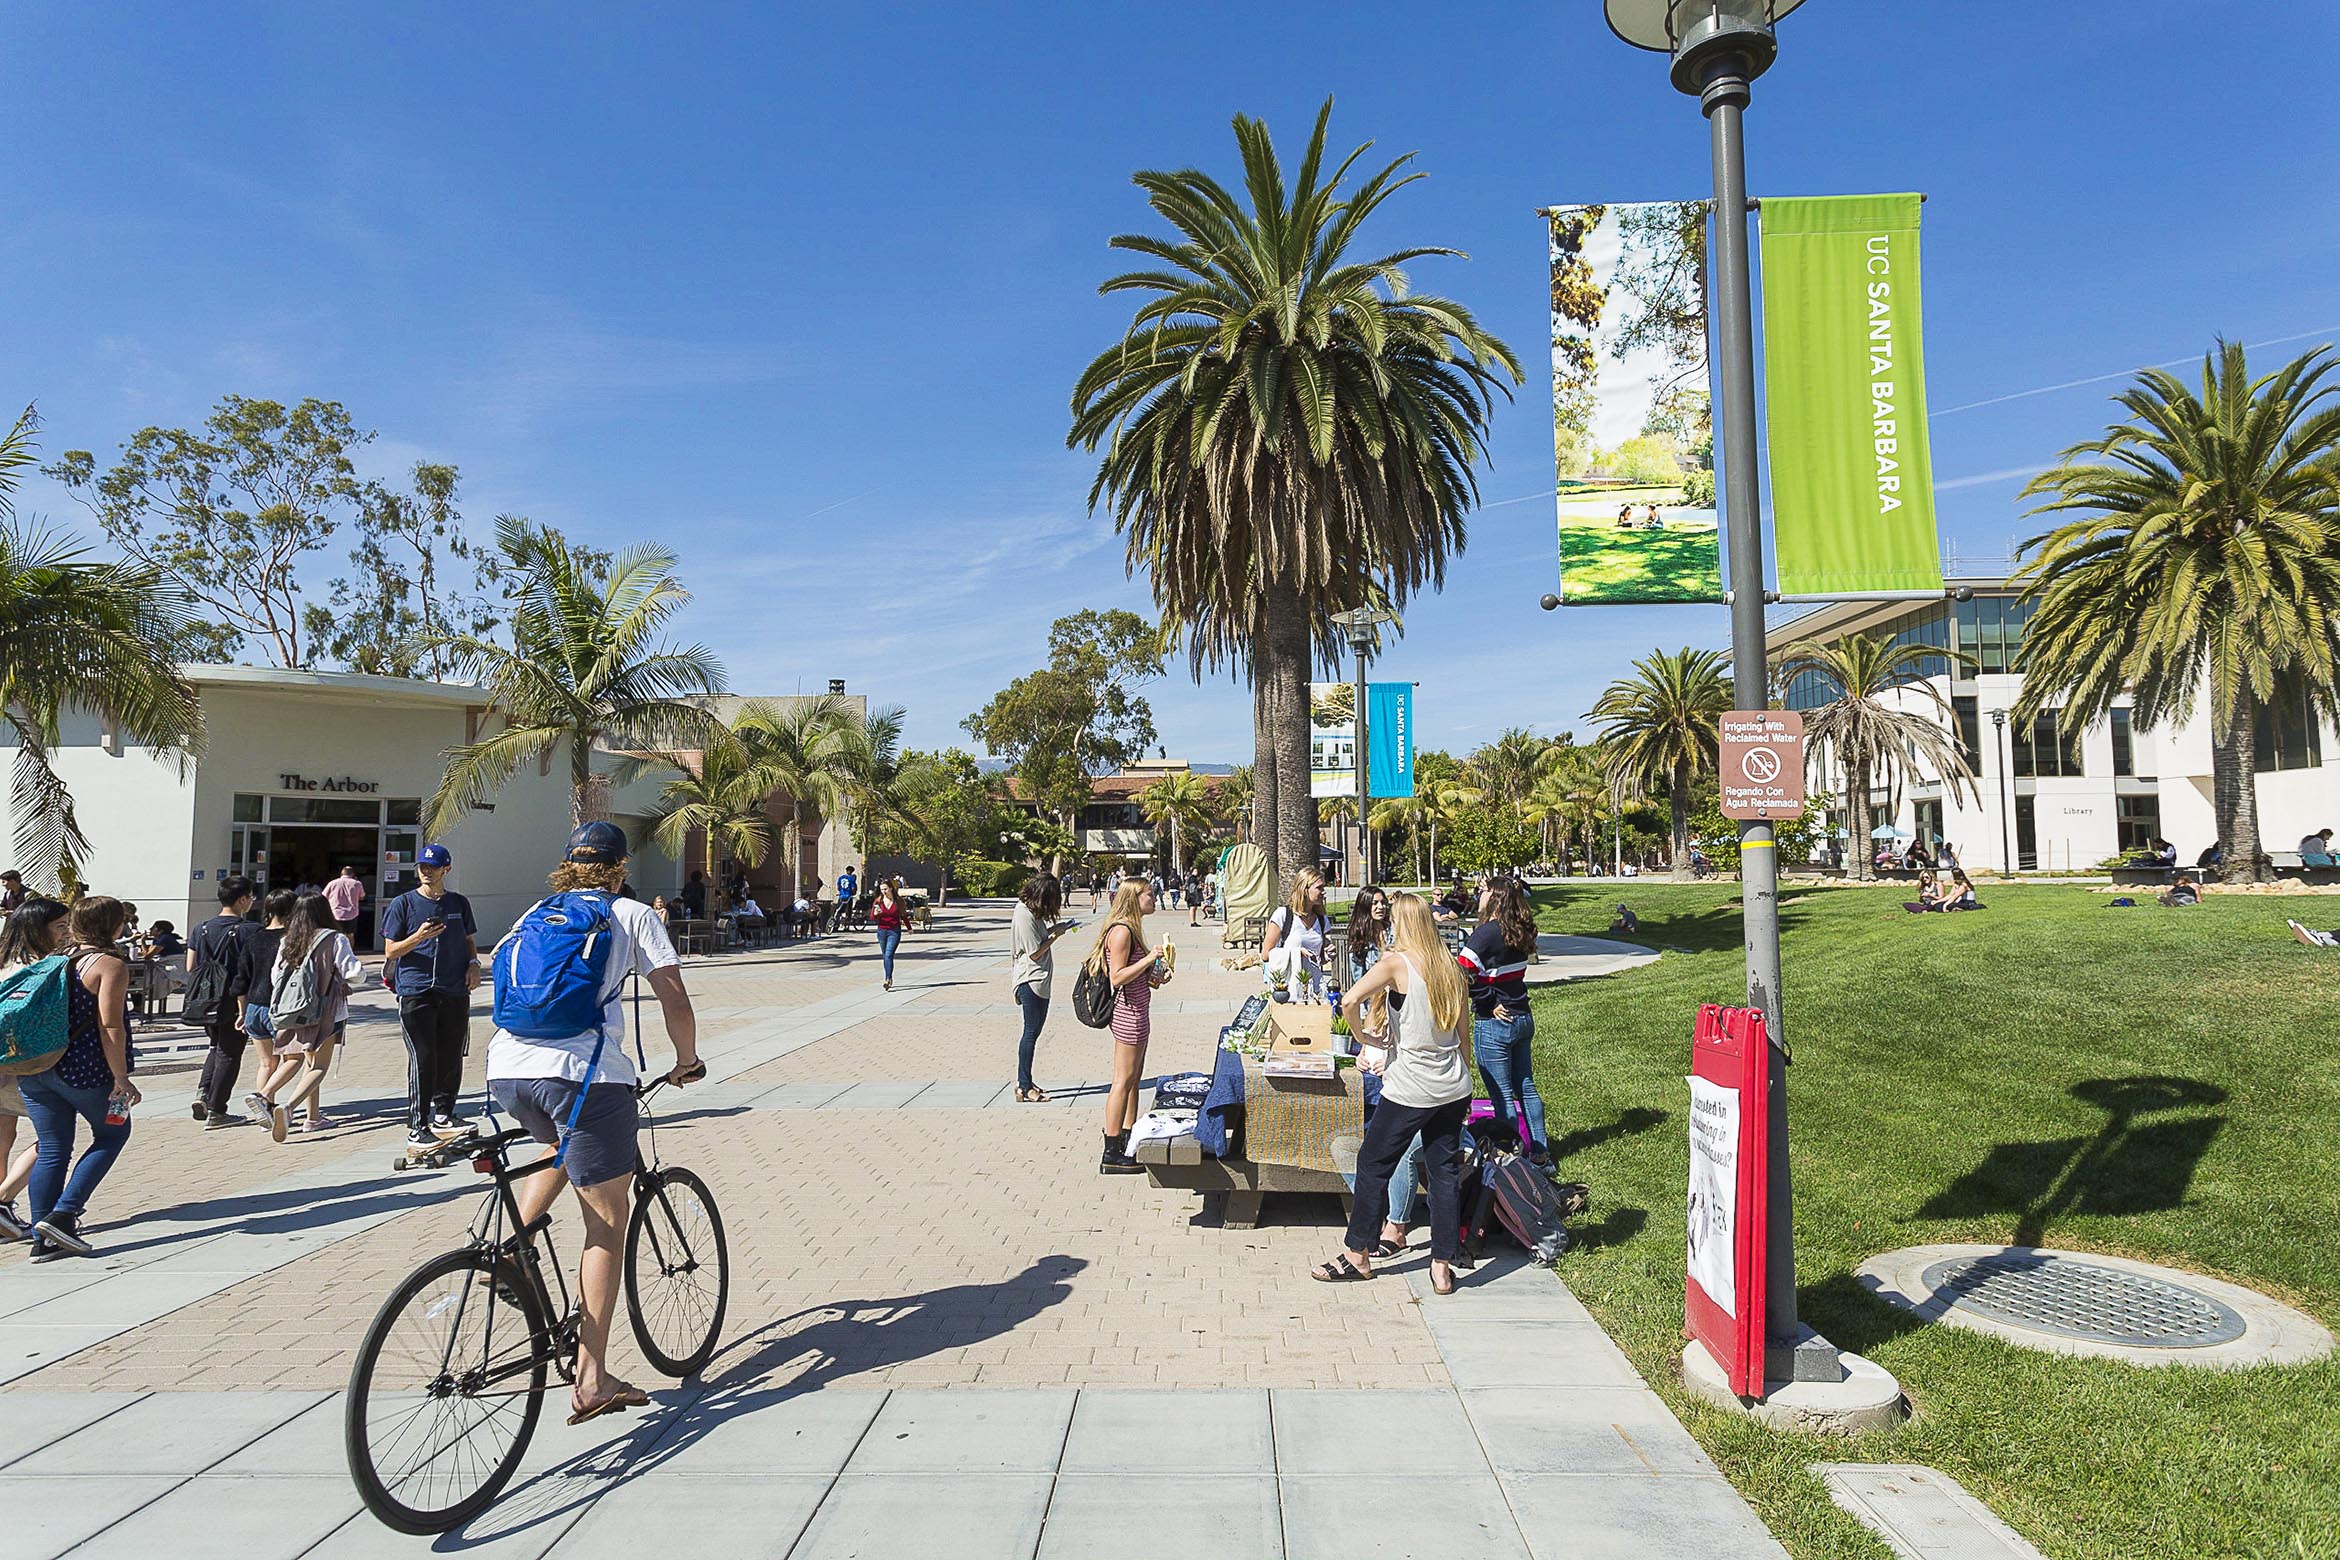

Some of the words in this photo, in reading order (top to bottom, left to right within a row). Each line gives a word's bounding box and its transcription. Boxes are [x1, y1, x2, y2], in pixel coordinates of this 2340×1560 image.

[1866, 234, 1890, 276] UC
[1867, 282, 1893, 377] SANTA
[1871, 381, 1902, 515] BARBARA
[1397, 694, 1405, 706] UC
[1397, 707, 1405, 734] SANTA
[1724, 722, 1763, 732] Irrigating
[1765, 722, 1785, 731] With
[1724, 733, 1769, 743] Reclaimed
[1772, 733, 1797, 743] Water
[280, 774, 318, 791] The
[321, 776, 379, 793] Arbor
[1725, 786, 1763, 797] Regando
[1766, 786, 1784, 796] Con
[1726, 798, 1748, 809] Agua
[1751, 798, 1798, 808] Reclamada
[2063, 807, 2093, 816] Library
